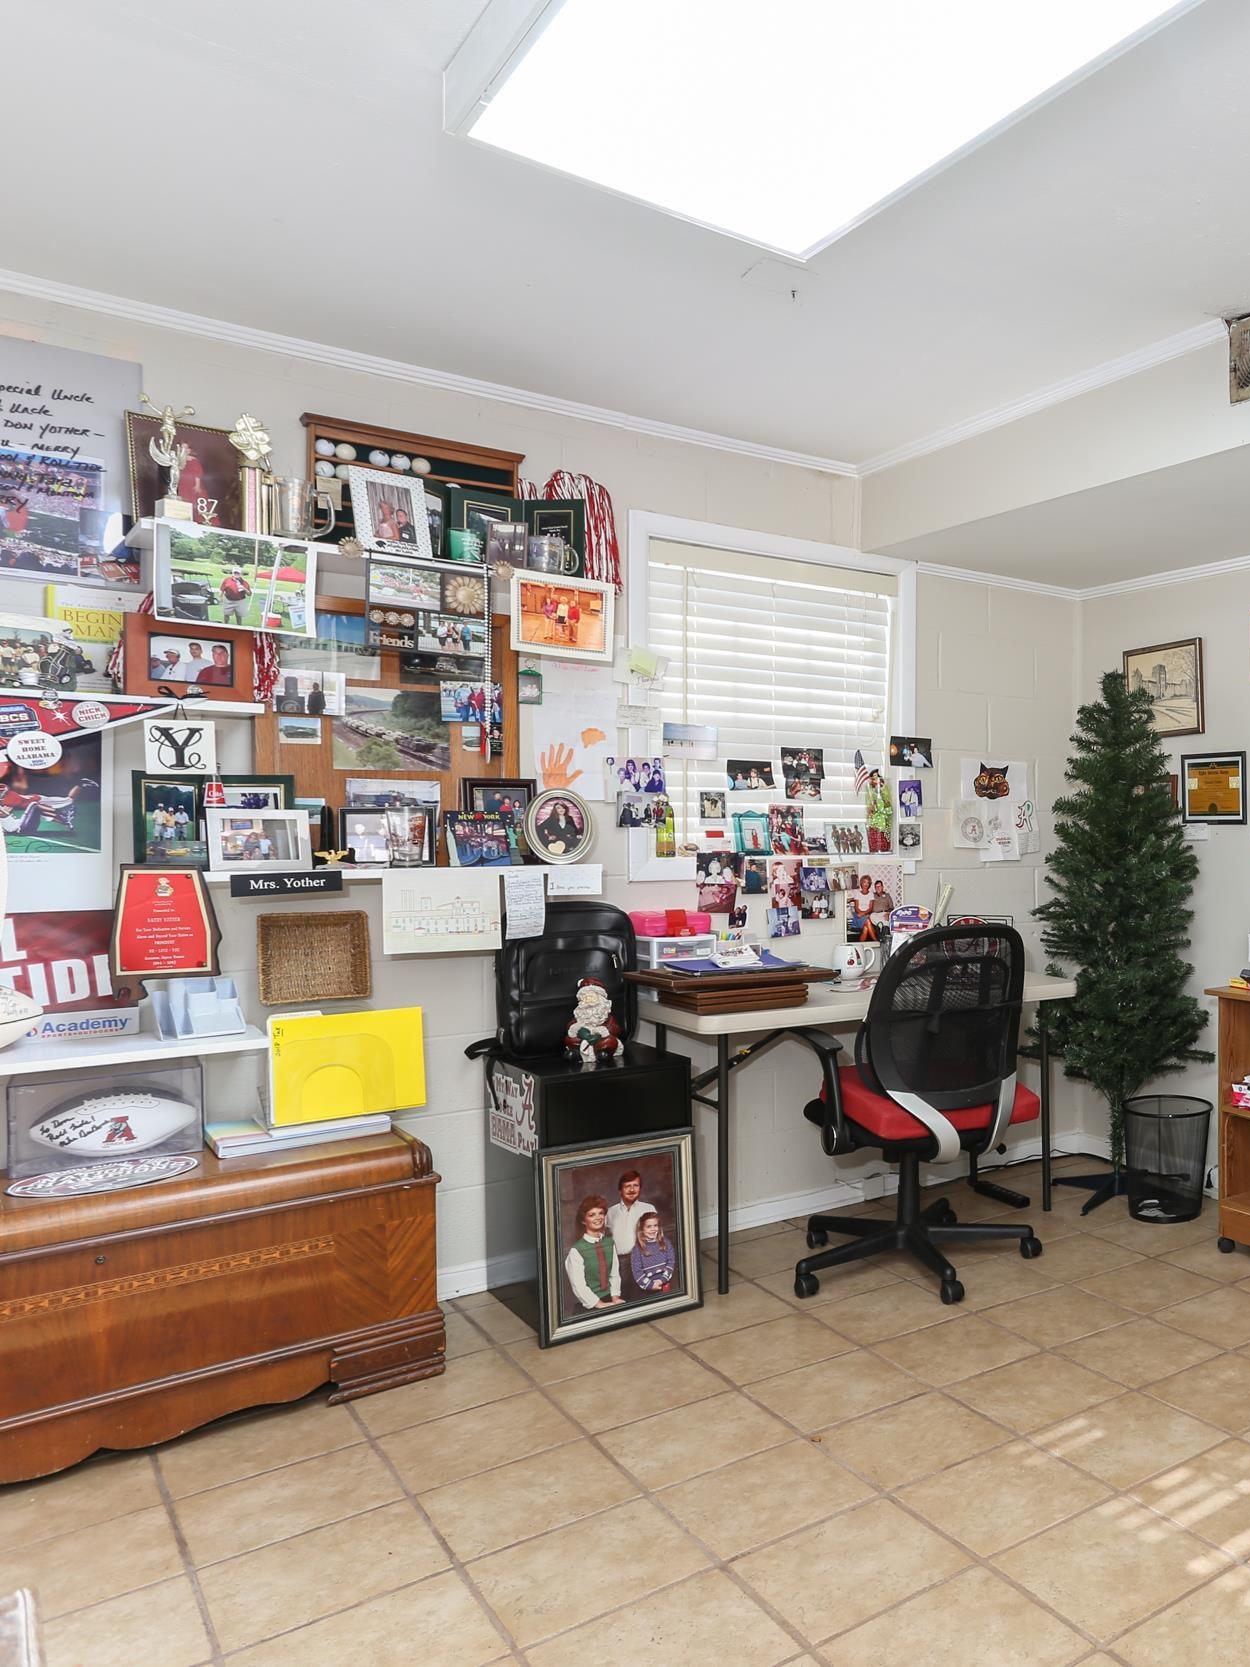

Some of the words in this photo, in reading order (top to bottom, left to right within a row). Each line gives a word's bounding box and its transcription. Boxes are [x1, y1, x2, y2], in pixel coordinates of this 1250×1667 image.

[51, 388, 95, 404] Uncle
[9, 403, 53, 416] Uncle
[3, 418, 34, 430] DON
[39, 423, 91, 439] YOTHER
[196, 498, 219, 513] 87
[368, 629, 415, 650] Friends
[16, 752, 56, 761] ALABAMA
[249, 879, 280, 890] Mrs.
[283, 877, 326, 888] Yother
[41, 1017, 129, 1034] Academy
